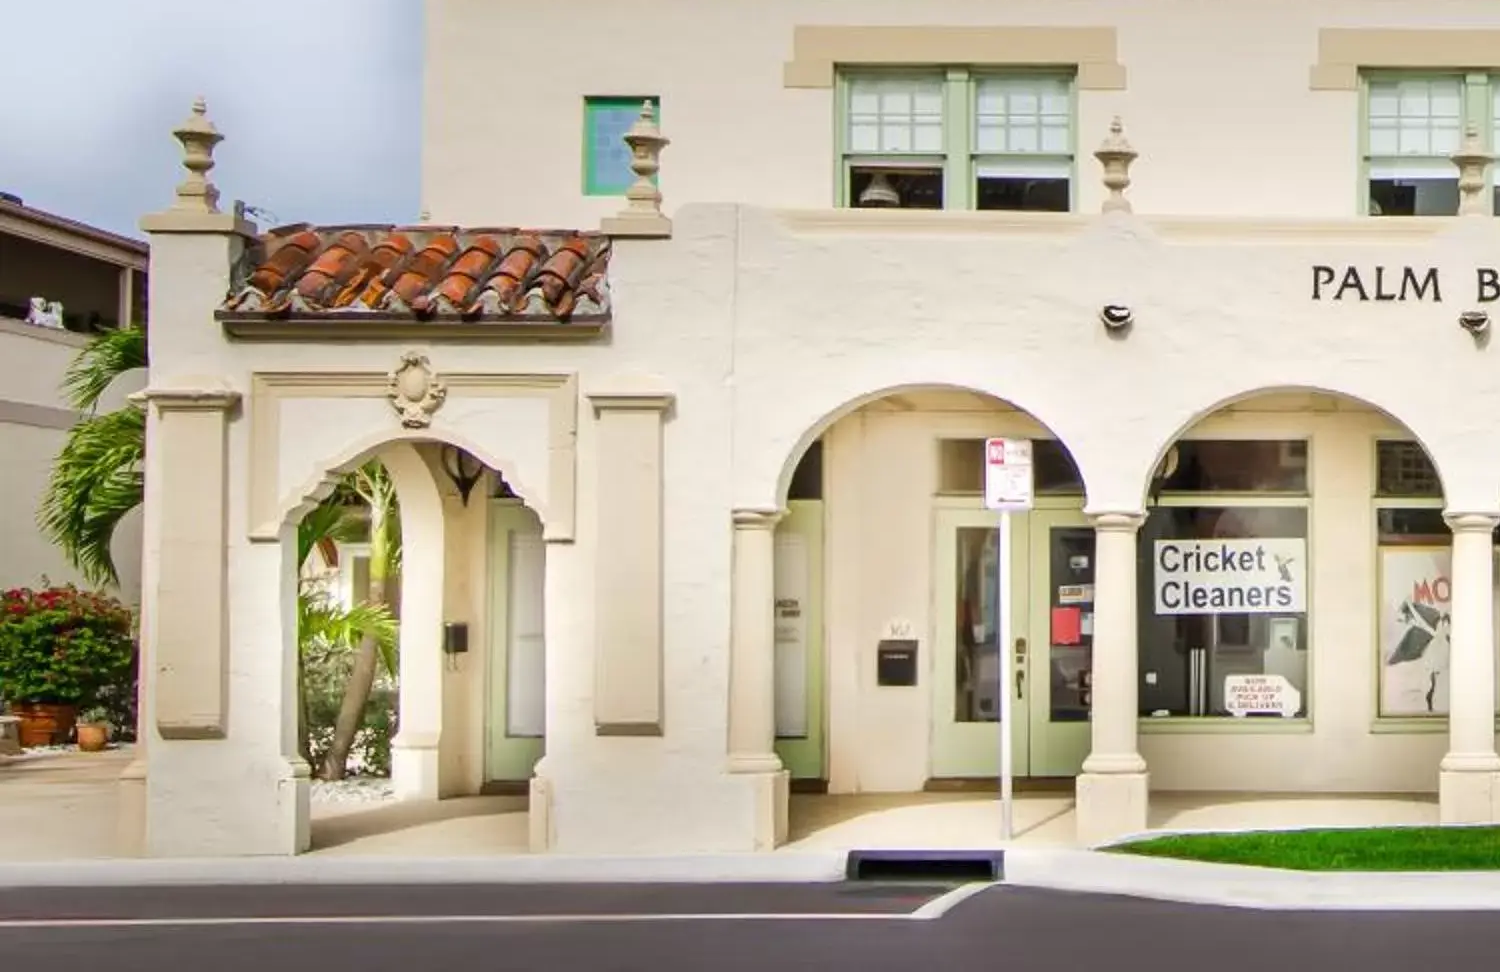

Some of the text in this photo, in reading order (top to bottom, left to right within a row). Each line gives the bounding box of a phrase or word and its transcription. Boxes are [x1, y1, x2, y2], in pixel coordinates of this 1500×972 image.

[1311, 265, 1442, 301] PALM
[1159, 544, 1265, 573] Cricket
[1160, 581, 1293, 608] Cleaners
